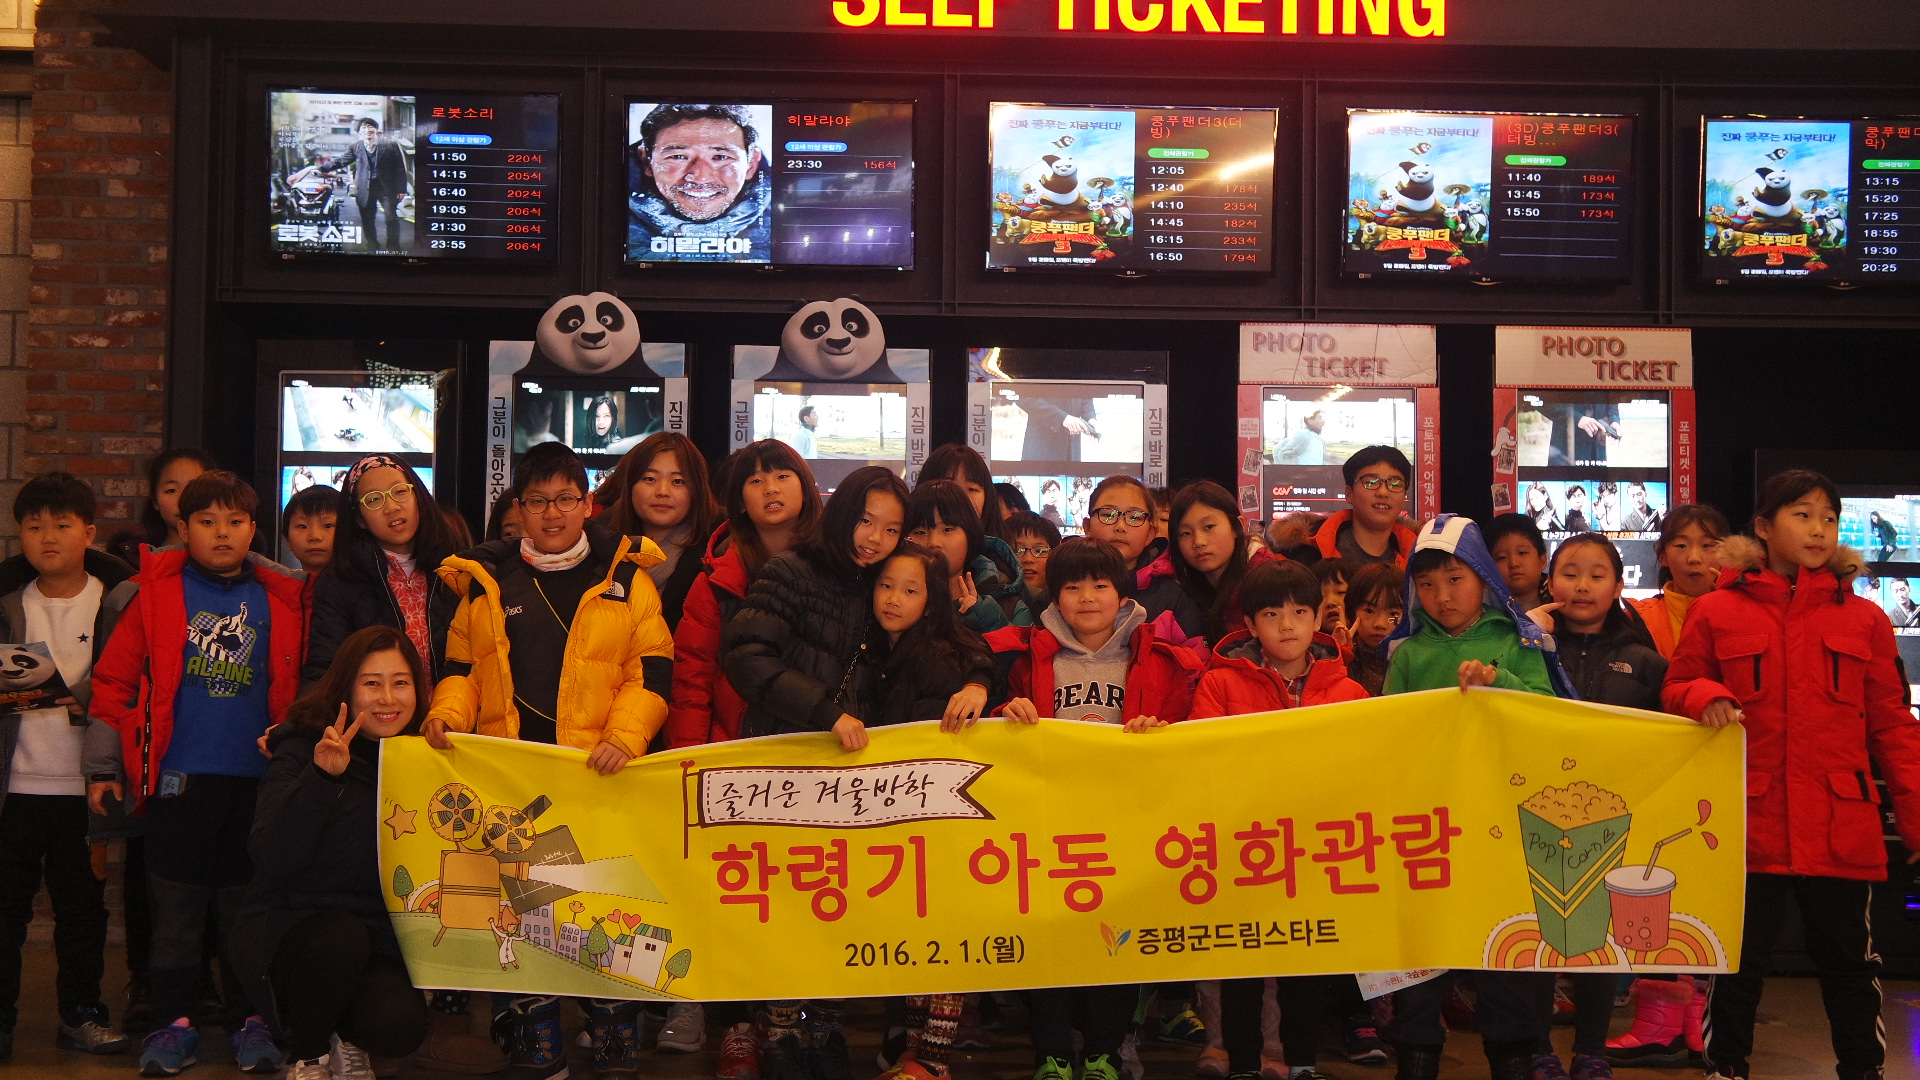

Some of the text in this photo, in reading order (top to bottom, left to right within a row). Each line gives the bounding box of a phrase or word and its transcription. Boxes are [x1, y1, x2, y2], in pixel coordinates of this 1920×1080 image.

[431, 107, 494, 120] 로봇소리
[787, 114, 851, 127] 히말라야
[1150, 127, 1171, 139] 빙)
[1721, 132, 1742, 142] 진짜
[1783, 133, 1837, 143] 지금부터다!
[1865, 138, 1887, 150] 막)
[432, 153, 467, 161] 11:50
[508, 155, 542, 163] 220석
[787, 160, 823, 169] 23:30
[863, 161, 897, 170] 156석
[432, 170, 467, 179] 14:15
[1151, 166, 1185, 175] 12:05
[507, 172, 542, 181] 205석
[1507, 173, 1542, 182] 11:40
[1582, 175, 1616, 183] 189석
[1865, 177, 1900, 186] 13:15
[1150, 183, 1185, 192] 12:40
[1225, 185, 1258, 194] 178석
[432, 188, 466, 197] 16:40
[507, 190, 541, 199] 202석
[1507, 190, 1541, 199] 13:45
[1582, 192, 1615, 201] 173석
[1865, 195, 1899, 203] 15:20
[432, 205, 466, 214] 19:05
[1150, 201, 1184, 210] 14:10
[1223, 202, 1257, 211] 235석
[507, 207, 541, 216] 206석
[1506, 208, 1540, 216] 15:50
[1581, 210, 1614, 218] 173석
[1864, 212, 1899, 220] 17:25
[1030, 219, 1095, 235] 쿵푸팬더
[1150, 218, 1184, 227] 14:45
[1224, 219, 1257, 228] 182석
[431, 223, 466, 232] 21:30
[507, 225, 541, 234] 206석
[277, 224, 362, 245] 로봇소리
[1386, 227, 1451, 242] 쿵푸팬더
[1864, 229, 1898, 238] 18:55
[1149, 235, 1184, 244] 16:15
[1223, 236, 1256, 245] 233석
[1743, 232, 1809, 247] 쿵푸팬더
[431, 240, 466, 249] 23:55
[506, 242, 541, 252] 206석
[650, 236, 753, 254] 히말라야
[1053, 240, 1072, 254] 3
[1863, 246, 1898, 255] 19:30
[1149, 252, 1183, 261] 16:50
[1224, 254, 1256, 263] 179석
[1765, 252, 1785, 266] 3
[1862, 264, 1897, 272] 20:25
[1252, 331, 1338, 354] PHOTO
[1541, 335, 1626, 357] PHOTO
[1302, 355, 1391, 379] TICKET
[1592, 359, 1678, 382] TICKET
[669, 401, 684, 430] 지금
[735, 401, 750, 444] 그분이
[911, 406, 926, 435] 지금
[1149, 408, 1164, 436] 지금
[972, 404, 987, 447] 그분이
[1423, 417, 1435, 466] 포토티켓
[1678, 421, 1691, 470] 포토티켓
[490, 396, 507, 510] 그분이 돌아오신
[911, 438, 925, 466] 바로
[1149, 440, 1164, 468] 바로
[1272, 486, 1291, 496] CGV
[1424, 470, 1435, 507] 어떻게
[187, 656, 254, 686] ALPINE
[715, 769, 935, 818] 즐거운 겨울방학
[711, 806, 1463, 923] 학령기 아동 영화관람
[1136, 918, 1341, 956] 증평군드림스타트
[844, 934, 1026, 967] 2016. 2. 1.(월)
